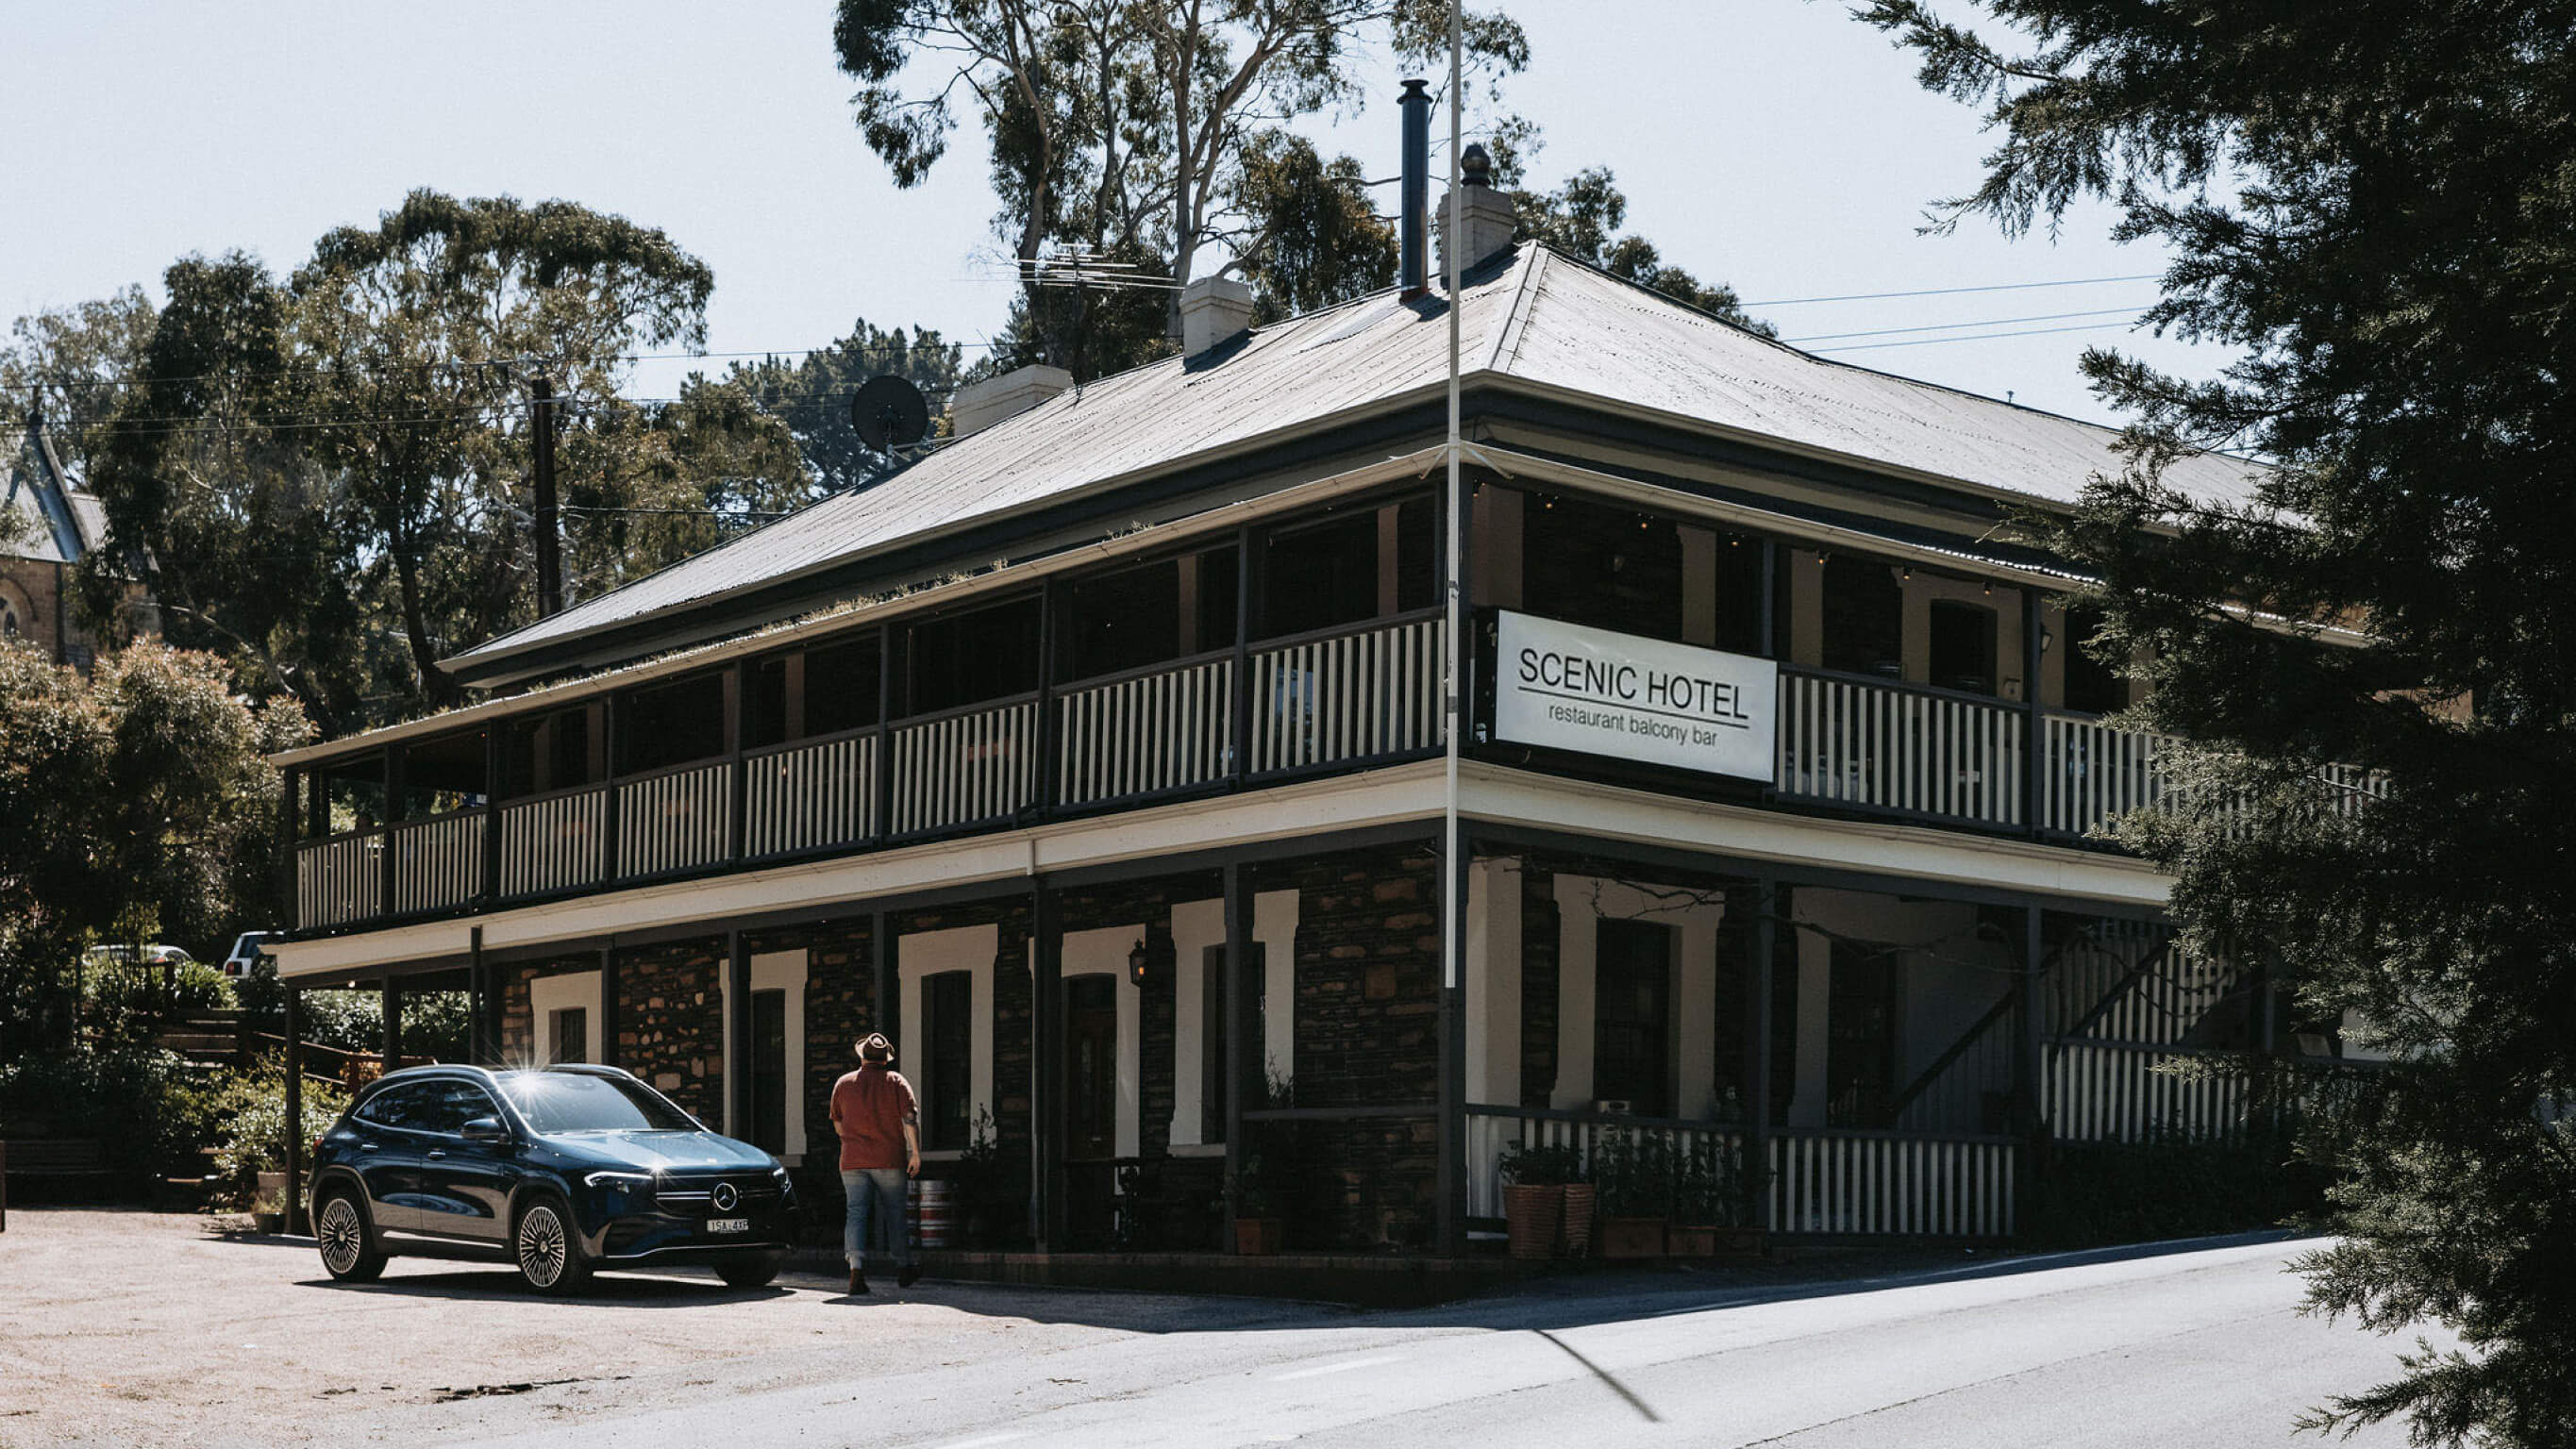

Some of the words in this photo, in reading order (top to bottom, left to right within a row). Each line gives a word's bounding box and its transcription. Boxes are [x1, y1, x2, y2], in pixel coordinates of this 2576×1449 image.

[1519, 648, 1637, 700] SCENIC
[1648, 671, 1749, 720] HOTEL
[1548, 704, 1625, 732] restaurant
[1630, 715, 1688, 745] balcony
[1693, 729, 1717, 747] bar
